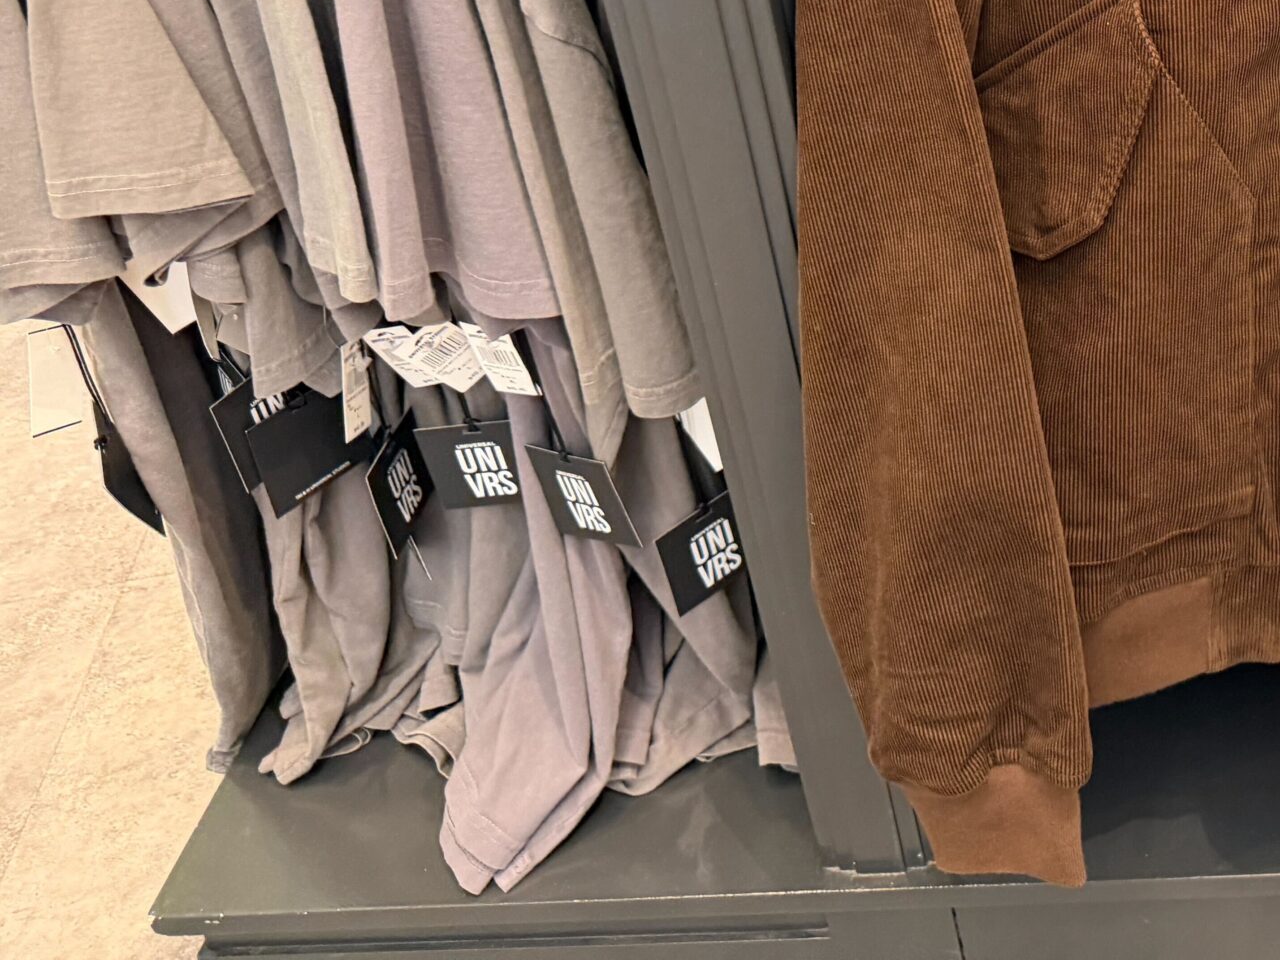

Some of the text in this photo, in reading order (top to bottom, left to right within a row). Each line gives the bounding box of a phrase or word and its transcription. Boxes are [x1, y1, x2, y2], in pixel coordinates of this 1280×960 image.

[387, 447, 414, 499] UNI
[454, 445, 508, 473] UNI
[397, 474, 423, 523] VRS
[464, 470, 518, 498] VRS
[556, 473, 600, 507] UNI
[567, 500, 612, 534] VRS
[690, 519, 735, 566] UNI
[697, 543, 742, 589] VRS
